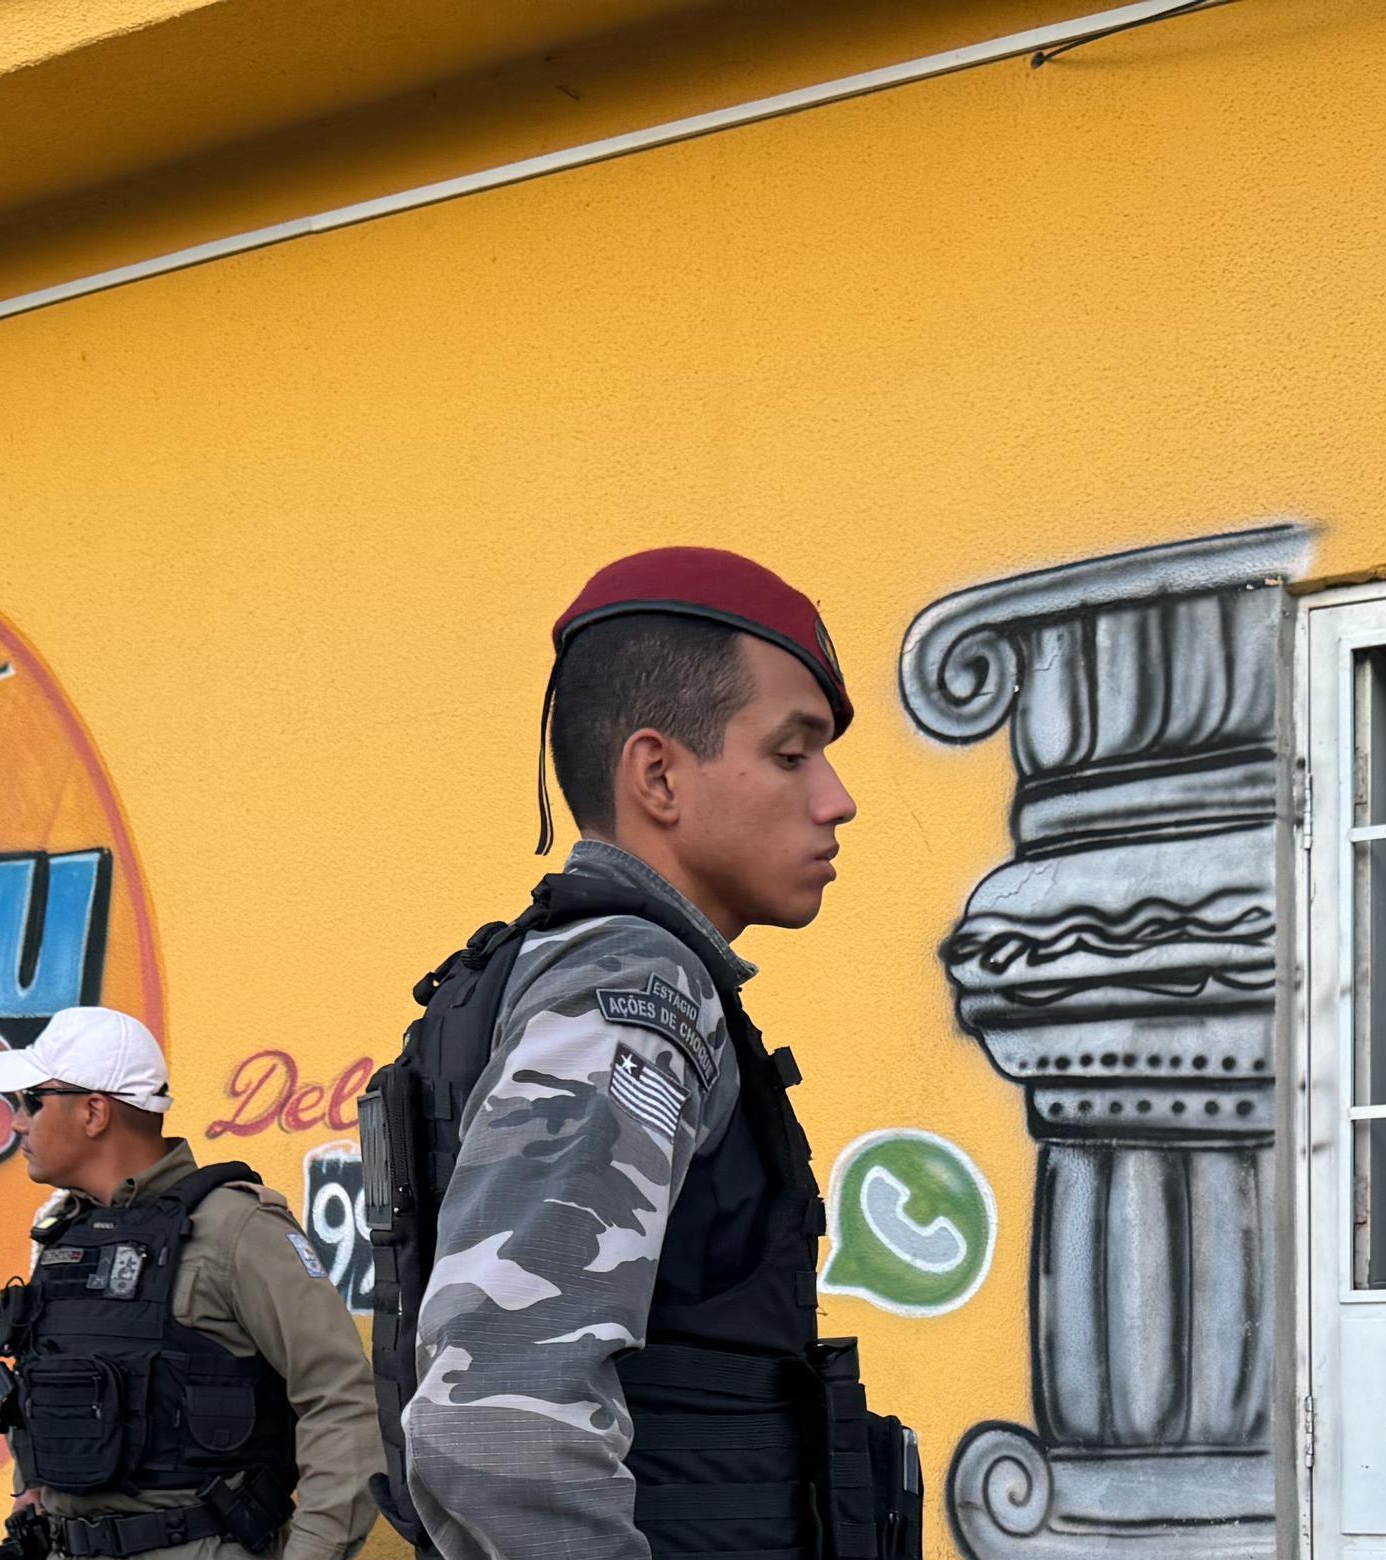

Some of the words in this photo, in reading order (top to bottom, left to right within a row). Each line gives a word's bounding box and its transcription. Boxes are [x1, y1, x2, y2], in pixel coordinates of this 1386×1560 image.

[609, 994, 656, 1019] AÇÕES
[660, 1007, 677, 1030] DE
[207, 1049, 375, 1139] Del
